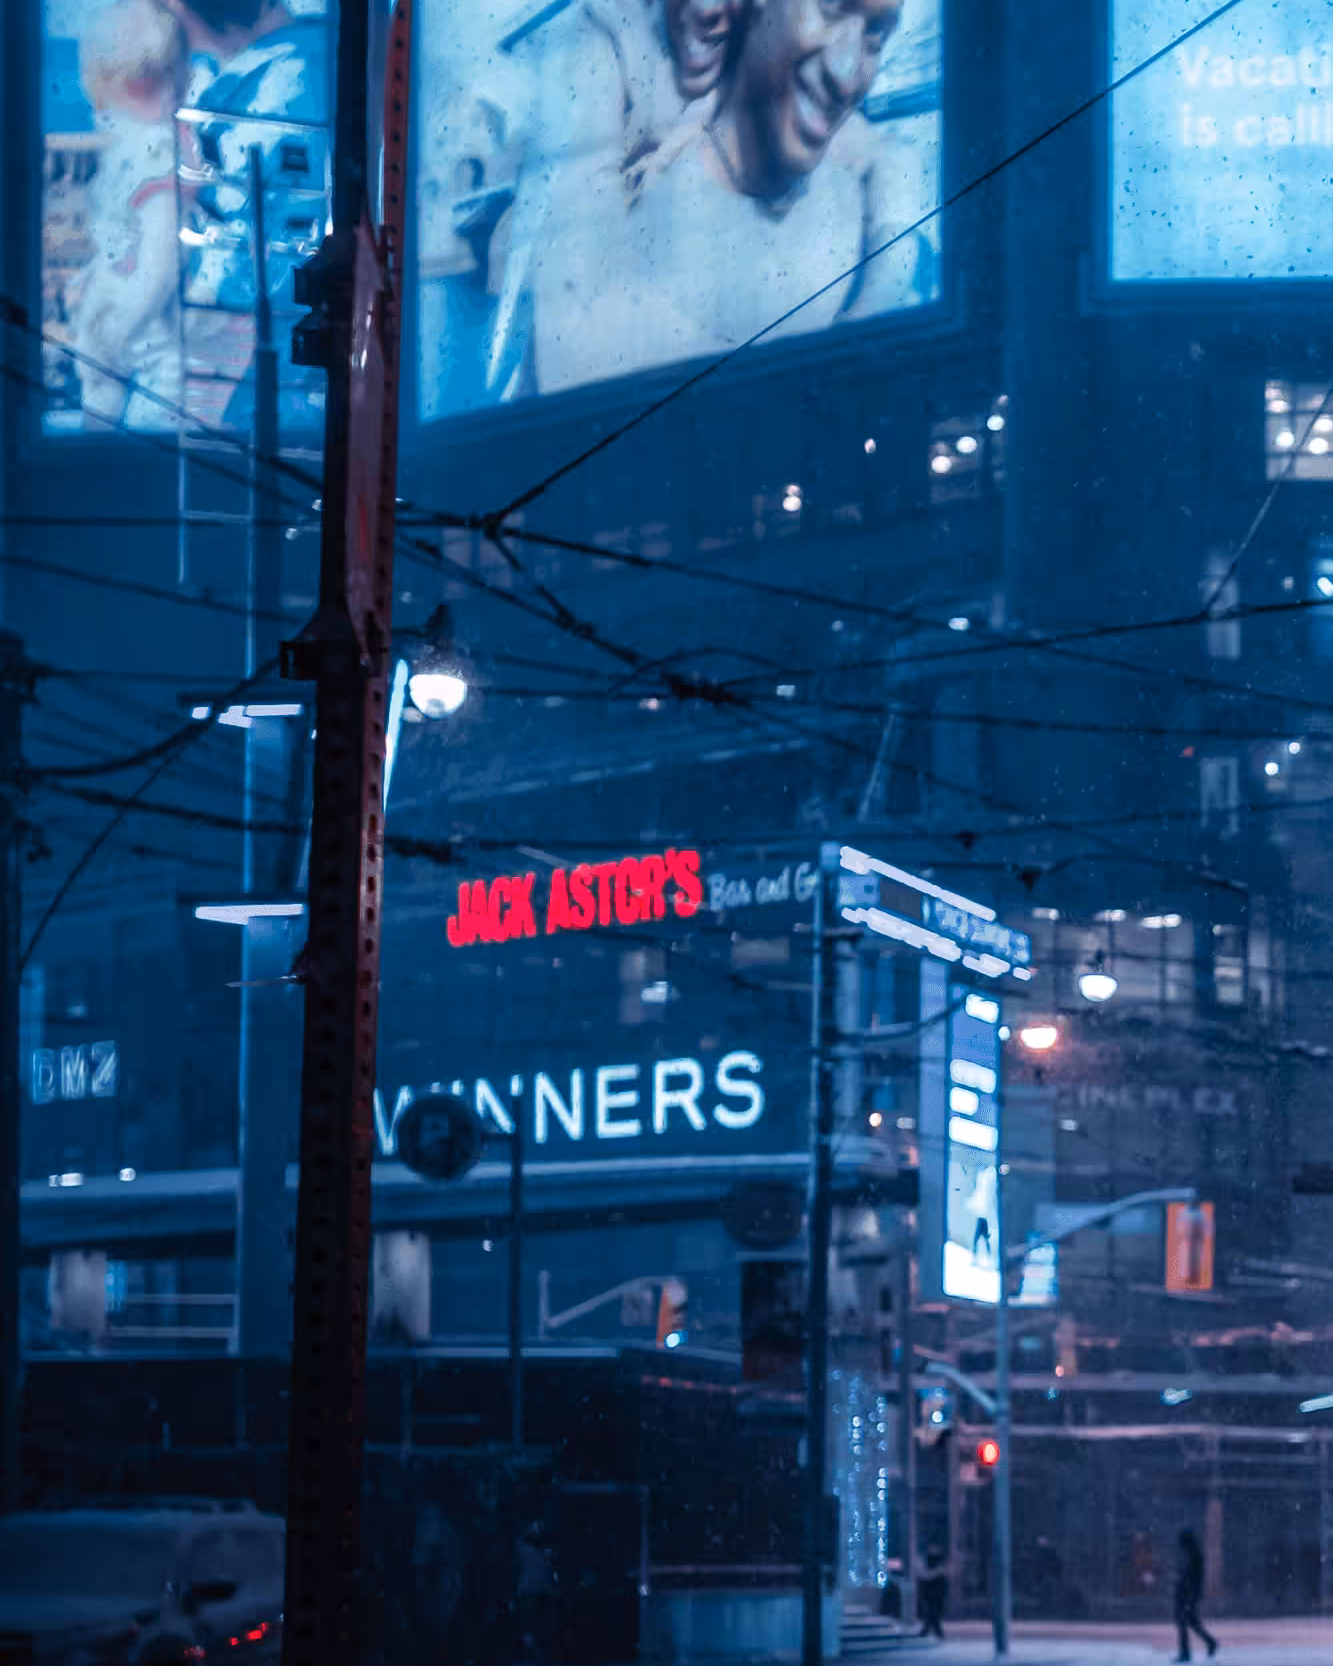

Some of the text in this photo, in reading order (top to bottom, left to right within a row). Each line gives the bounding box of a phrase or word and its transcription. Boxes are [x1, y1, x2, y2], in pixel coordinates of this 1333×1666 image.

[1181, 101, 1217, 147] is
[446, 872, 537, 948] JACK
[546, 847, 703, 936] ASTOR'S
[372, 1049, 766, 1157] WNNERS
